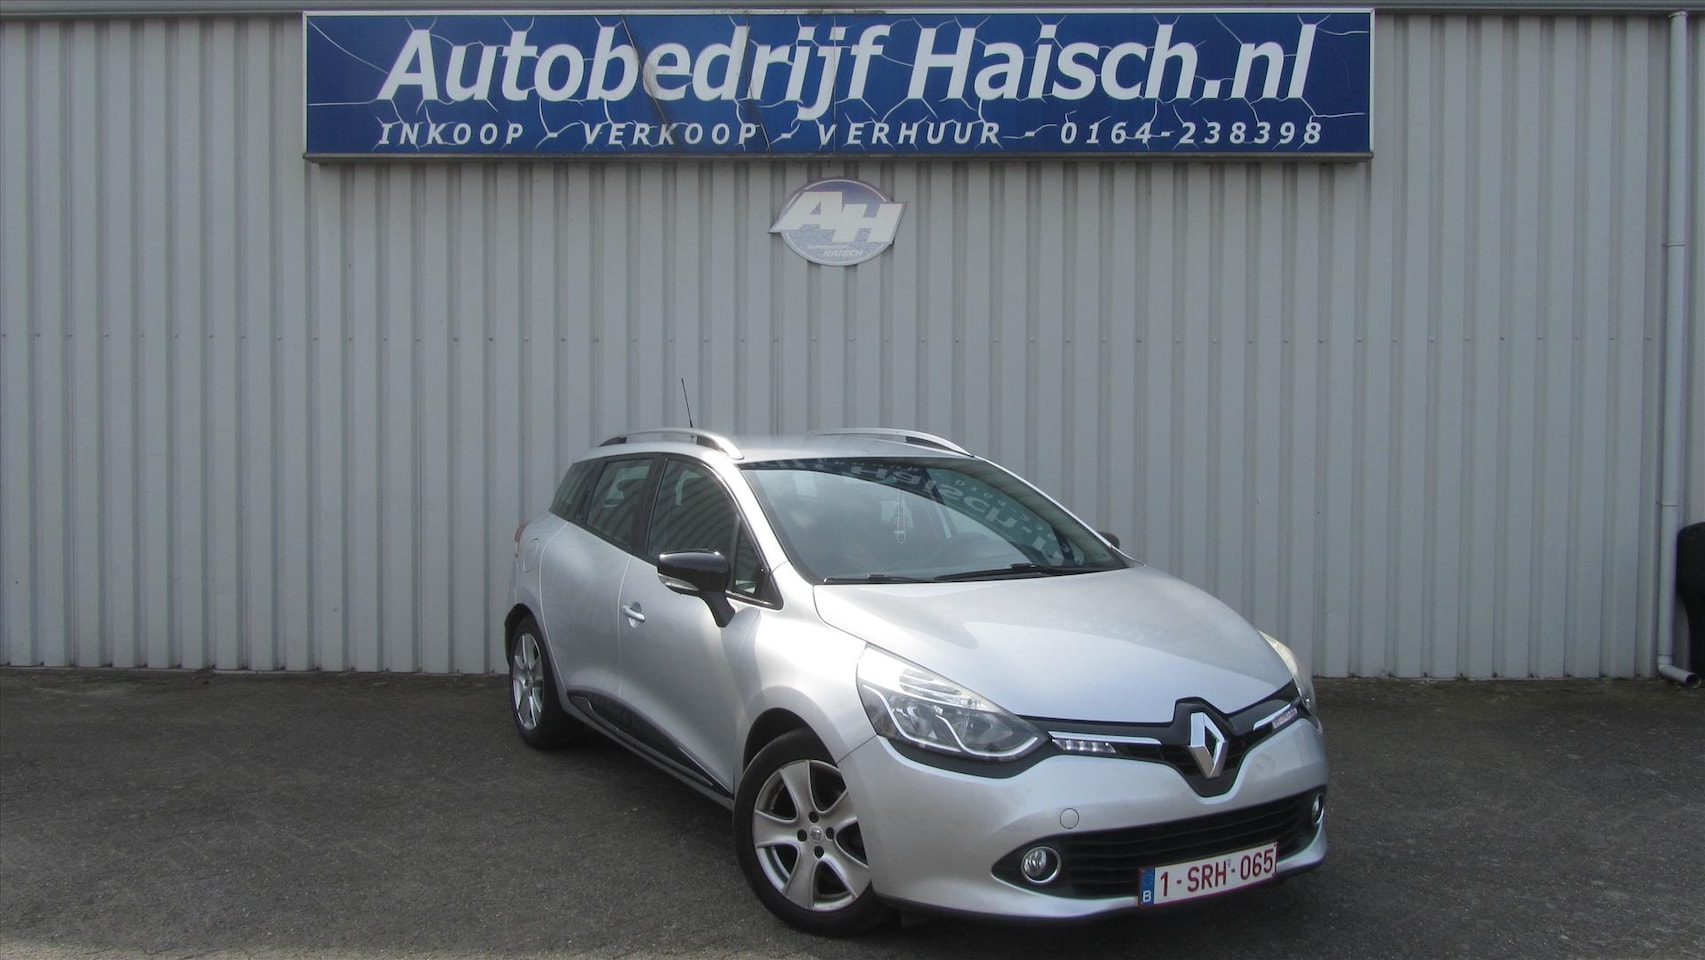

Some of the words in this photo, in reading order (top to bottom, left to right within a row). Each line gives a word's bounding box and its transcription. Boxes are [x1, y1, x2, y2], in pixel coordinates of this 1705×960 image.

[376, 25, 889, 120] Autobedrijf
[907, 23, 1317, 101] Haisch.nl
[379, 123, 524, 145] INKOOP
[585, 123, 757, 145] VERKOOP
[819, 122, 1000, 145] VERHUUR
[1060, 121, 1322, 145] 0164-238398
[769, 191, 903, 243] AH
[1142, 890, 1152, 903] B
